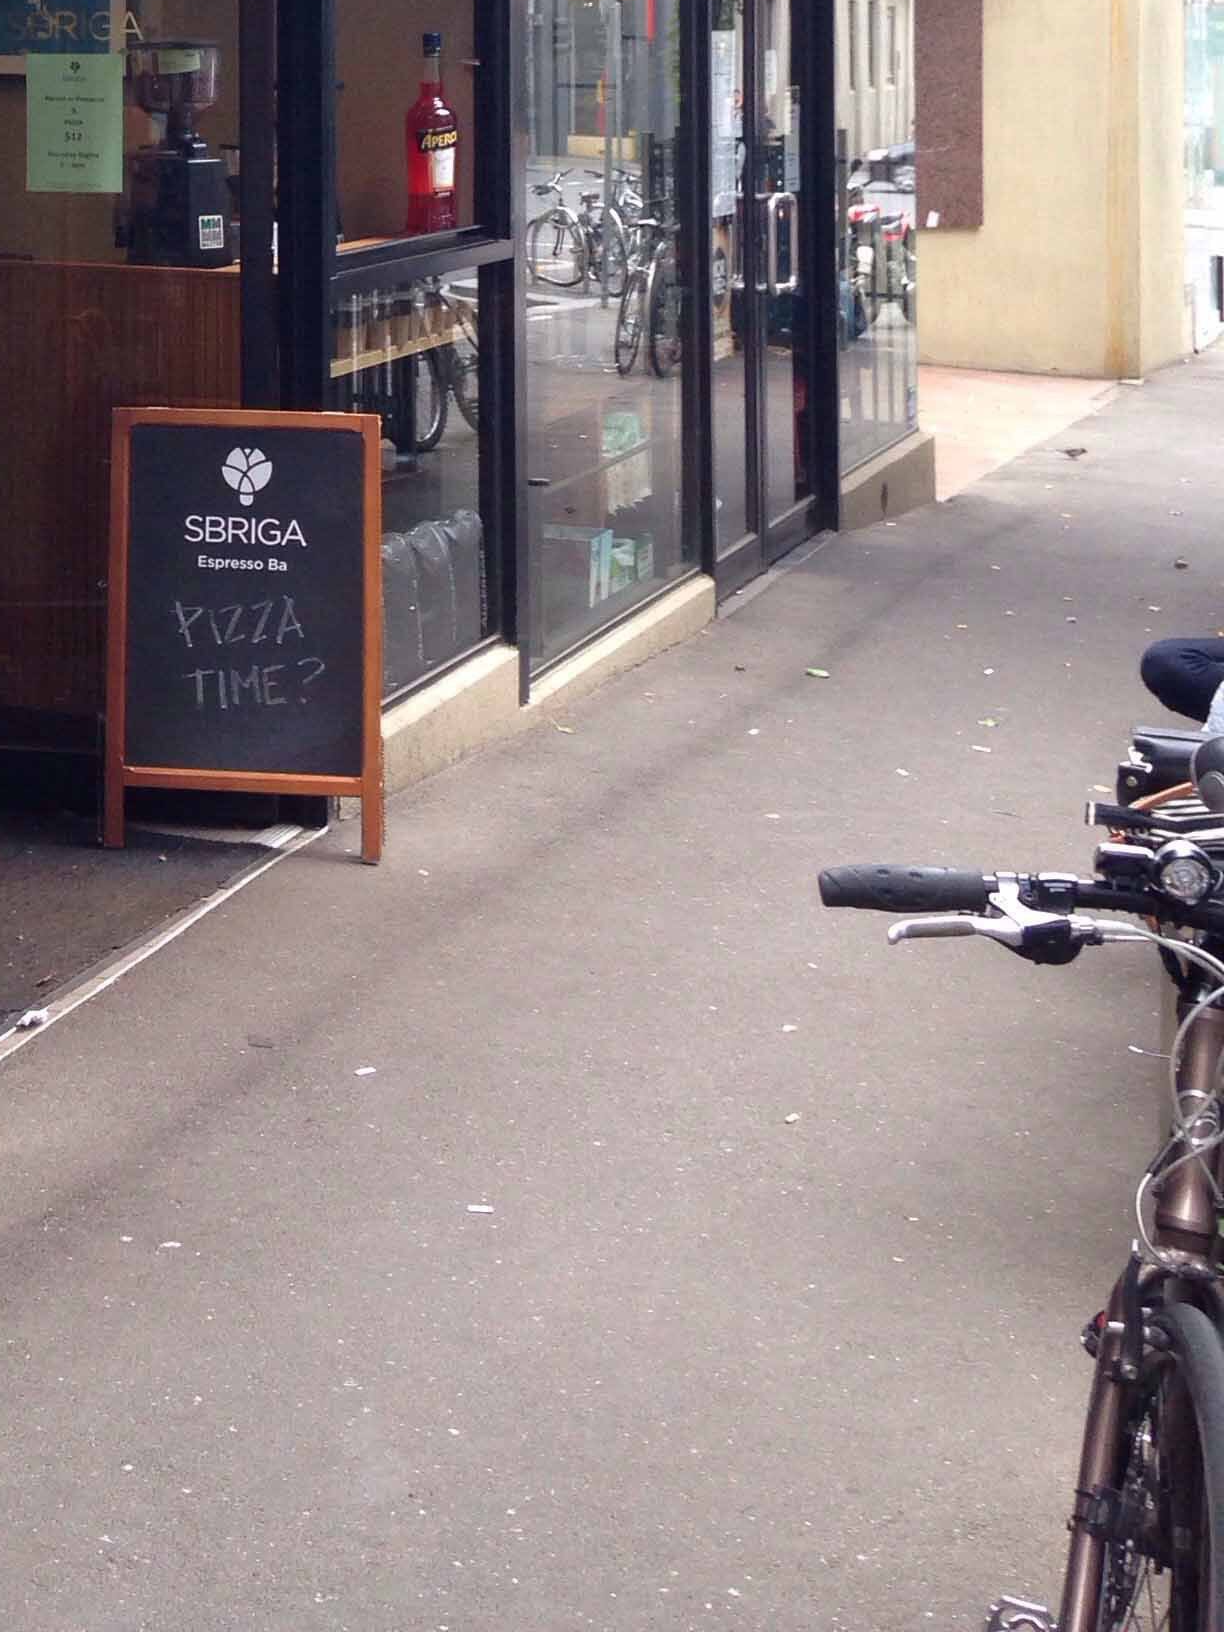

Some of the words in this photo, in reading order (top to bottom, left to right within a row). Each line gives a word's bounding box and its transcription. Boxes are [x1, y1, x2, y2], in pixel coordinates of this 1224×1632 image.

[184, 515, 307, 546] SBRIGA
[198, 555, 263, 571] Espresso
[268, 558, 287, 571] Ba
[170, 595, 304, 647] PIZZA
